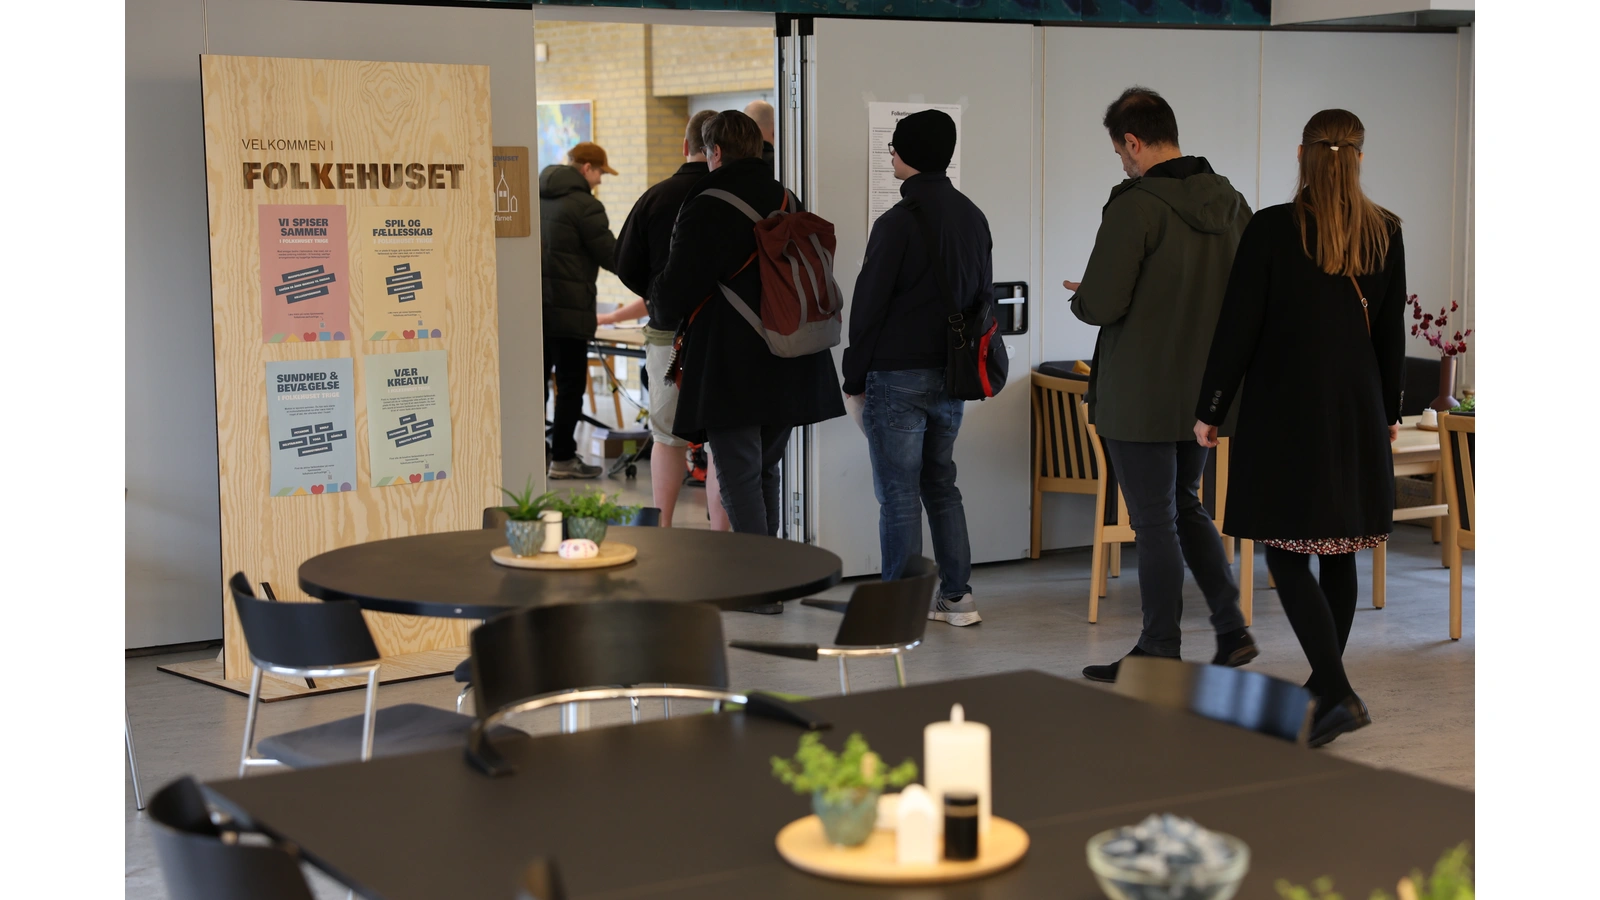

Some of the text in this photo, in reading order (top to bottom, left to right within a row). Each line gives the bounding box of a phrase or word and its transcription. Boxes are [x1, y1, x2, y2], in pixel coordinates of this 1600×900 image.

[242, 139, 333, 151] VELKOMMEN I
[242, 162, 464, 190] FOLKEHUSET
[278, 218, 328, 226] VI SPISER
[385, 219, 421, 227] SPIL OG
[281, 228, 327, 236] SAMMEN
[372, 228, 433, 236] FÆLLESSKAB
[277, 371, 338, 383] SUNDHED &
[394, 368, 418, 377] VÆR
[277, 381, 339, 392] BEVÆGELSE
[387, 376, 429, 387] KREATIV
